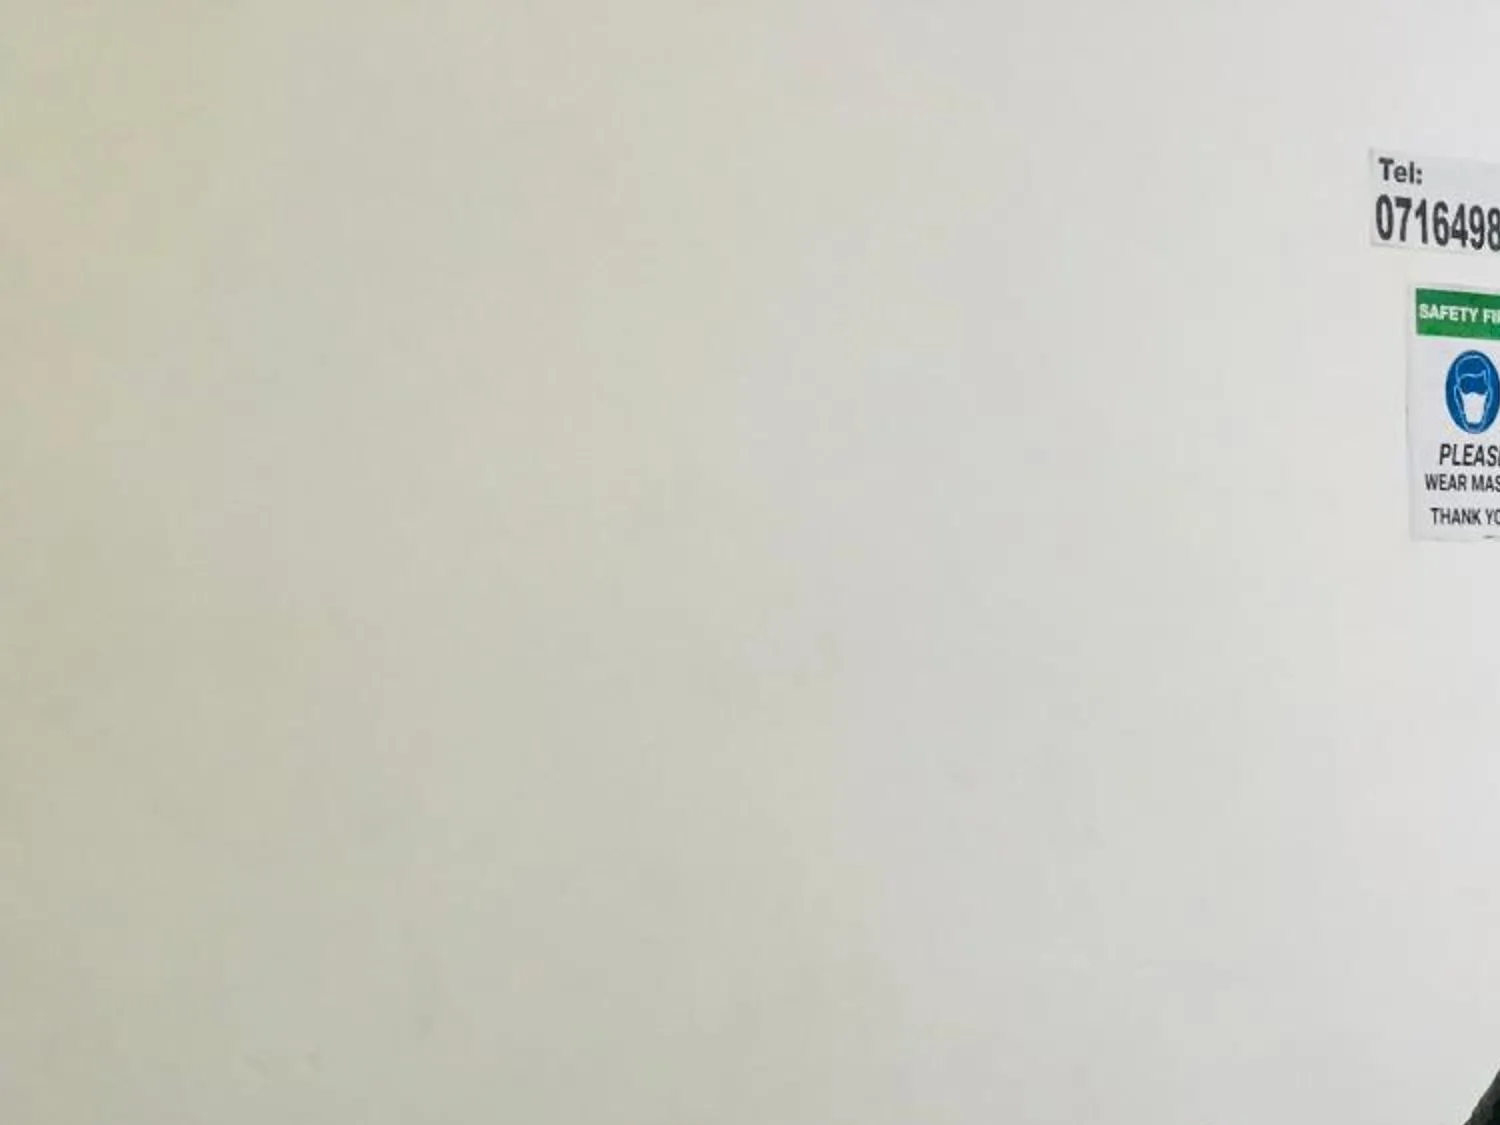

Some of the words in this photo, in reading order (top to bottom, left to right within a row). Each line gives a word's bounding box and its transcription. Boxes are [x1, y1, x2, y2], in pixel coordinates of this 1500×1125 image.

[1378, 157, 1423, 185] Tel:
[1419, 303, 1479, 323] SAFETY
[1425, 473, 1467, 491] WEAR
[1430, 507, 1481, 525] THANK
